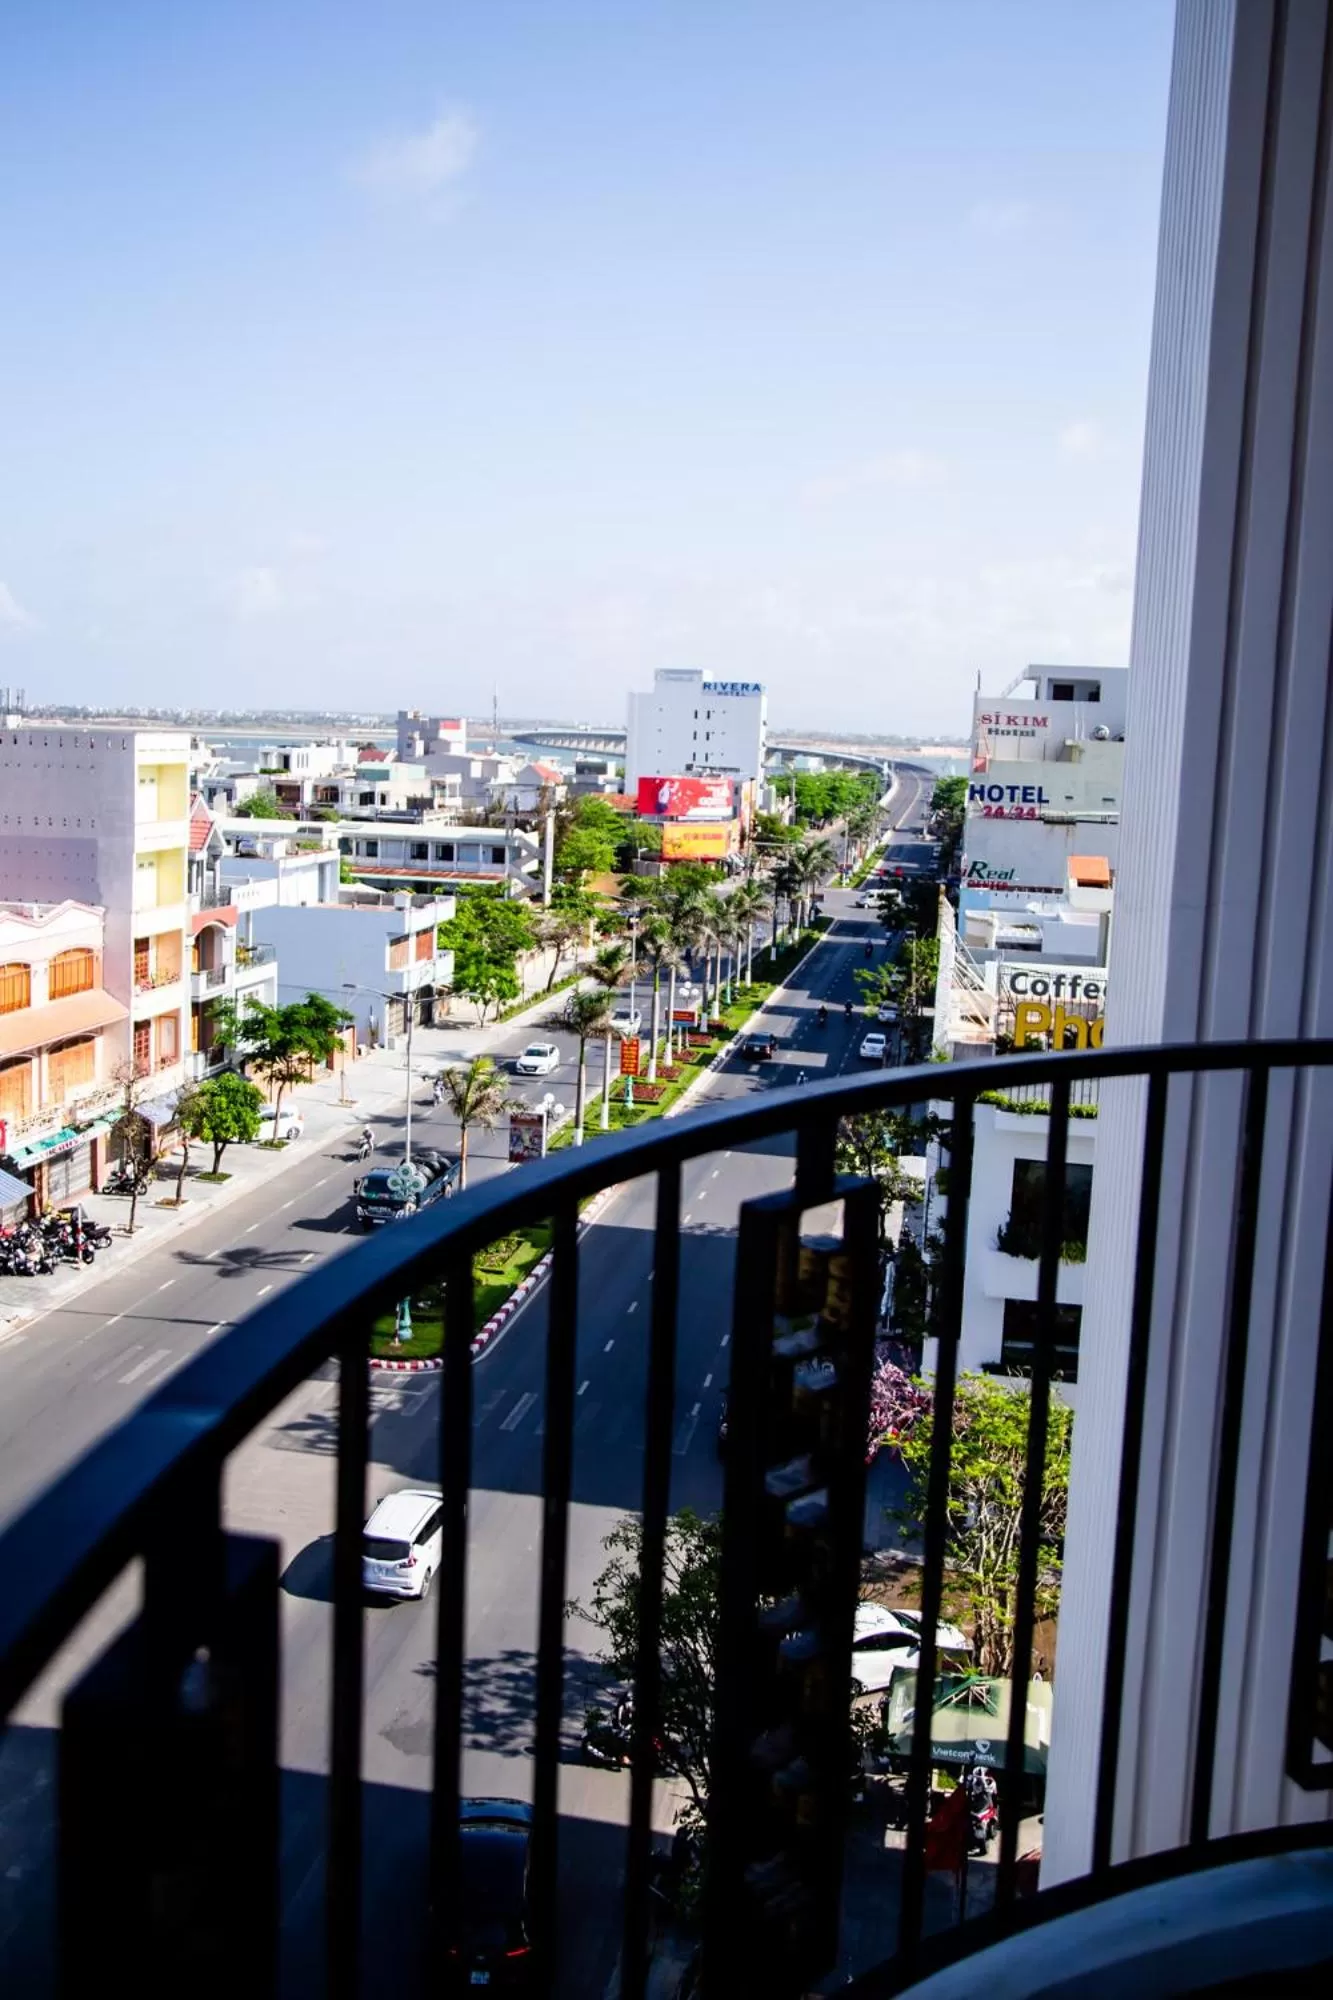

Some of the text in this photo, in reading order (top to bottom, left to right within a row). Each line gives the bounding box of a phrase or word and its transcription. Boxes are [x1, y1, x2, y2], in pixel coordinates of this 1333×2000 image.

[703, 681, 761, 692] RIVERA
[969, 783, 1050, 804] HOTEL
[983, 804, 1037, 819] 24/24
[1010, 971, 1108, 1000] Coffe
